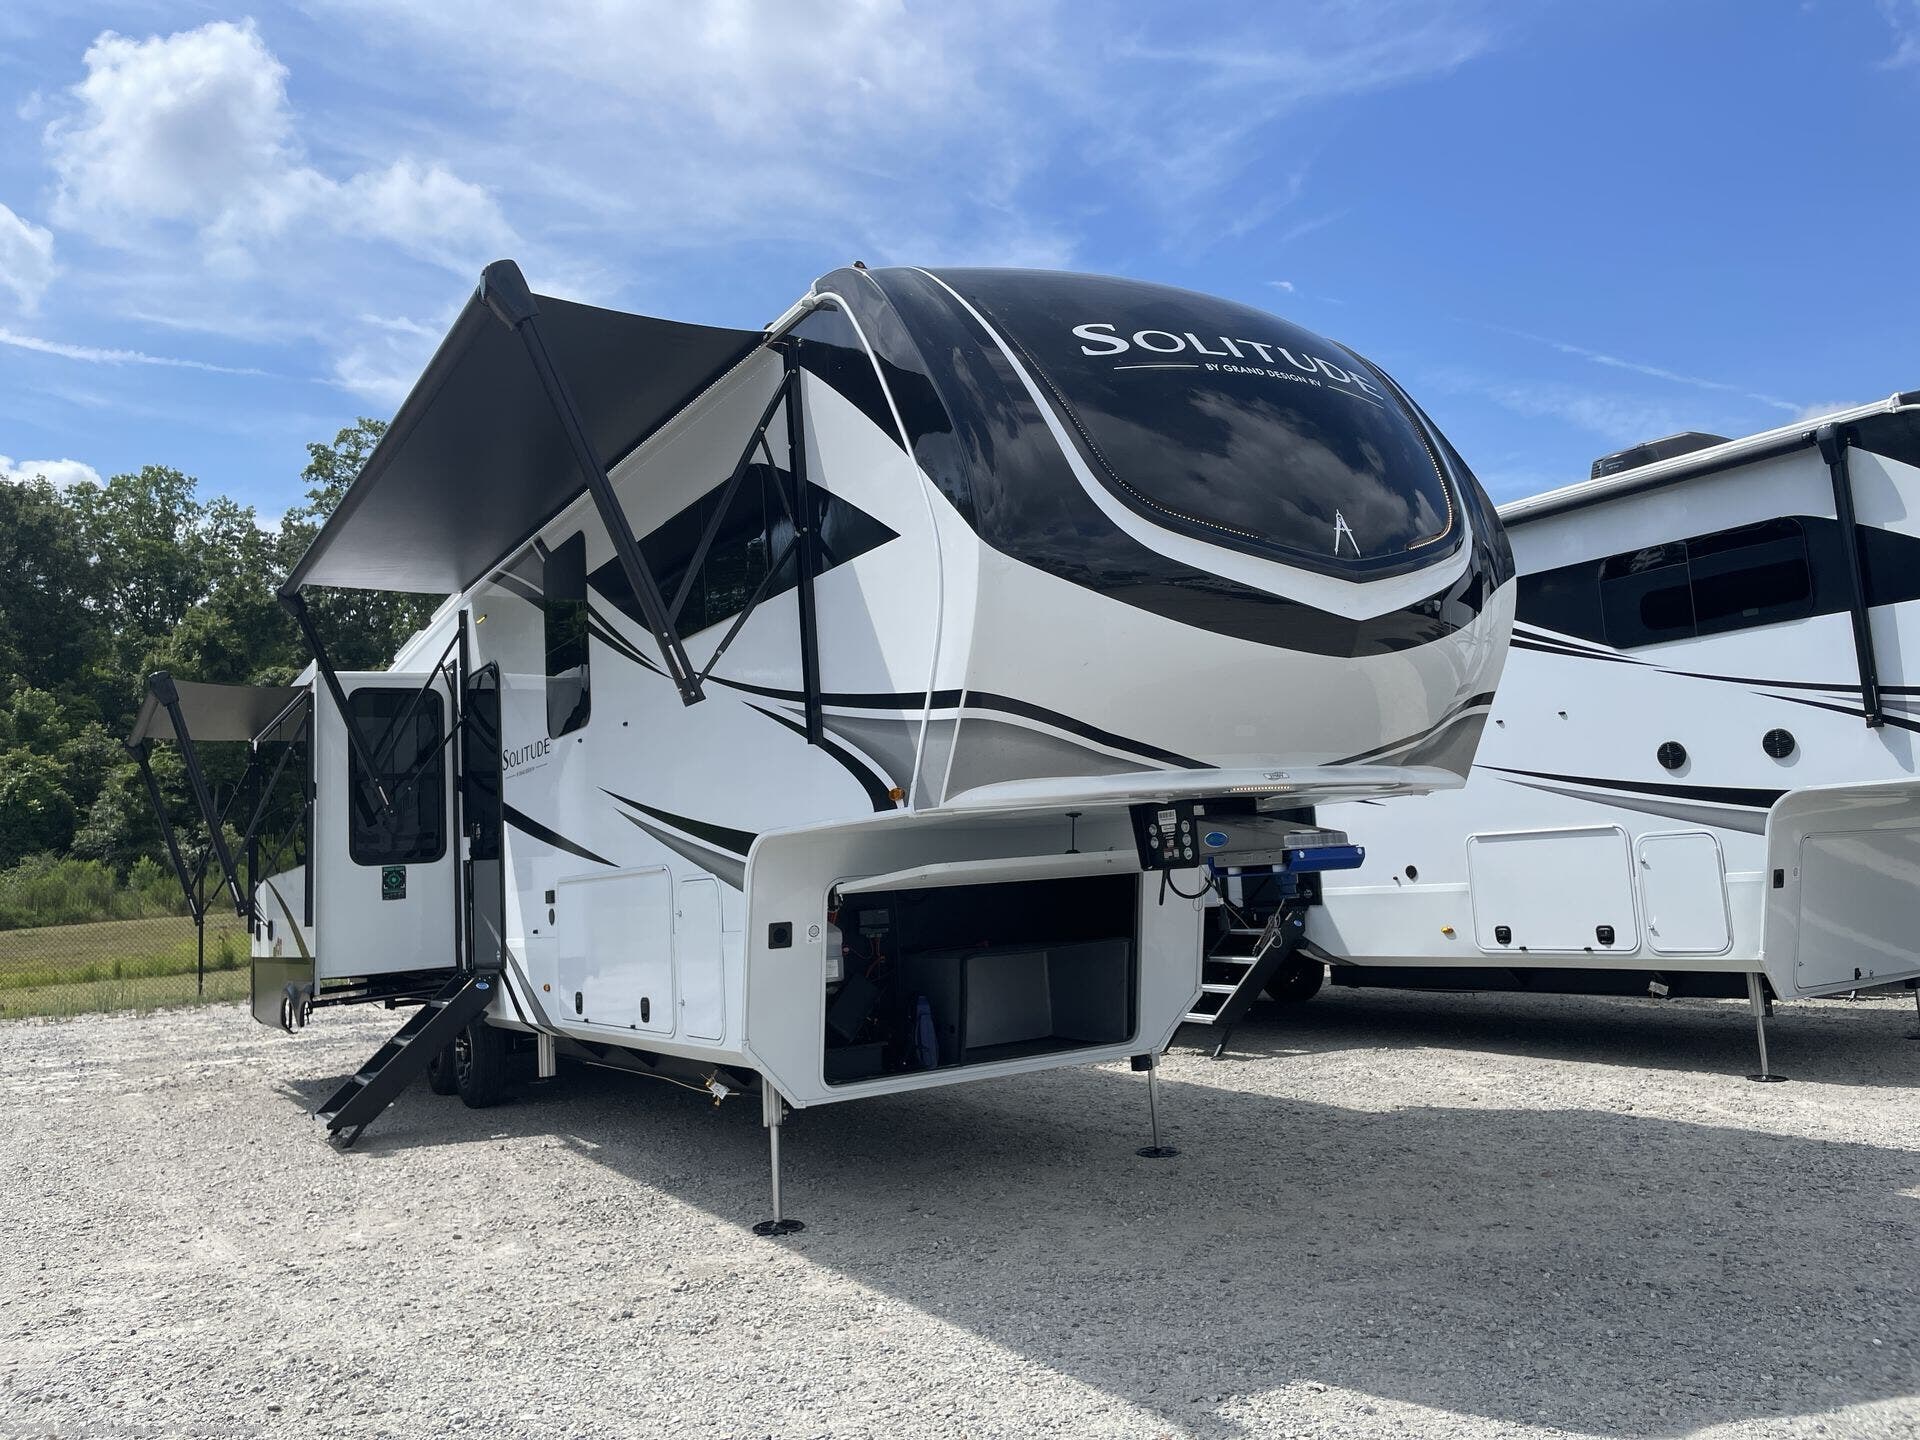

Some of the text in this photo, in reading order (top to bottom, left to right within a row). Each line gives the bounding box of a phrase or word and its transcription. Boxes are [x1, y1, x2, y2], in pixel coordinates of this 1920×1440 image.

[1072, 323, 1384, 400] SOLITUDE
[1205, 362, 1322, 387] BY GRAND DESIGN RV
[502, 737, 550, 771] SOLITUDE
